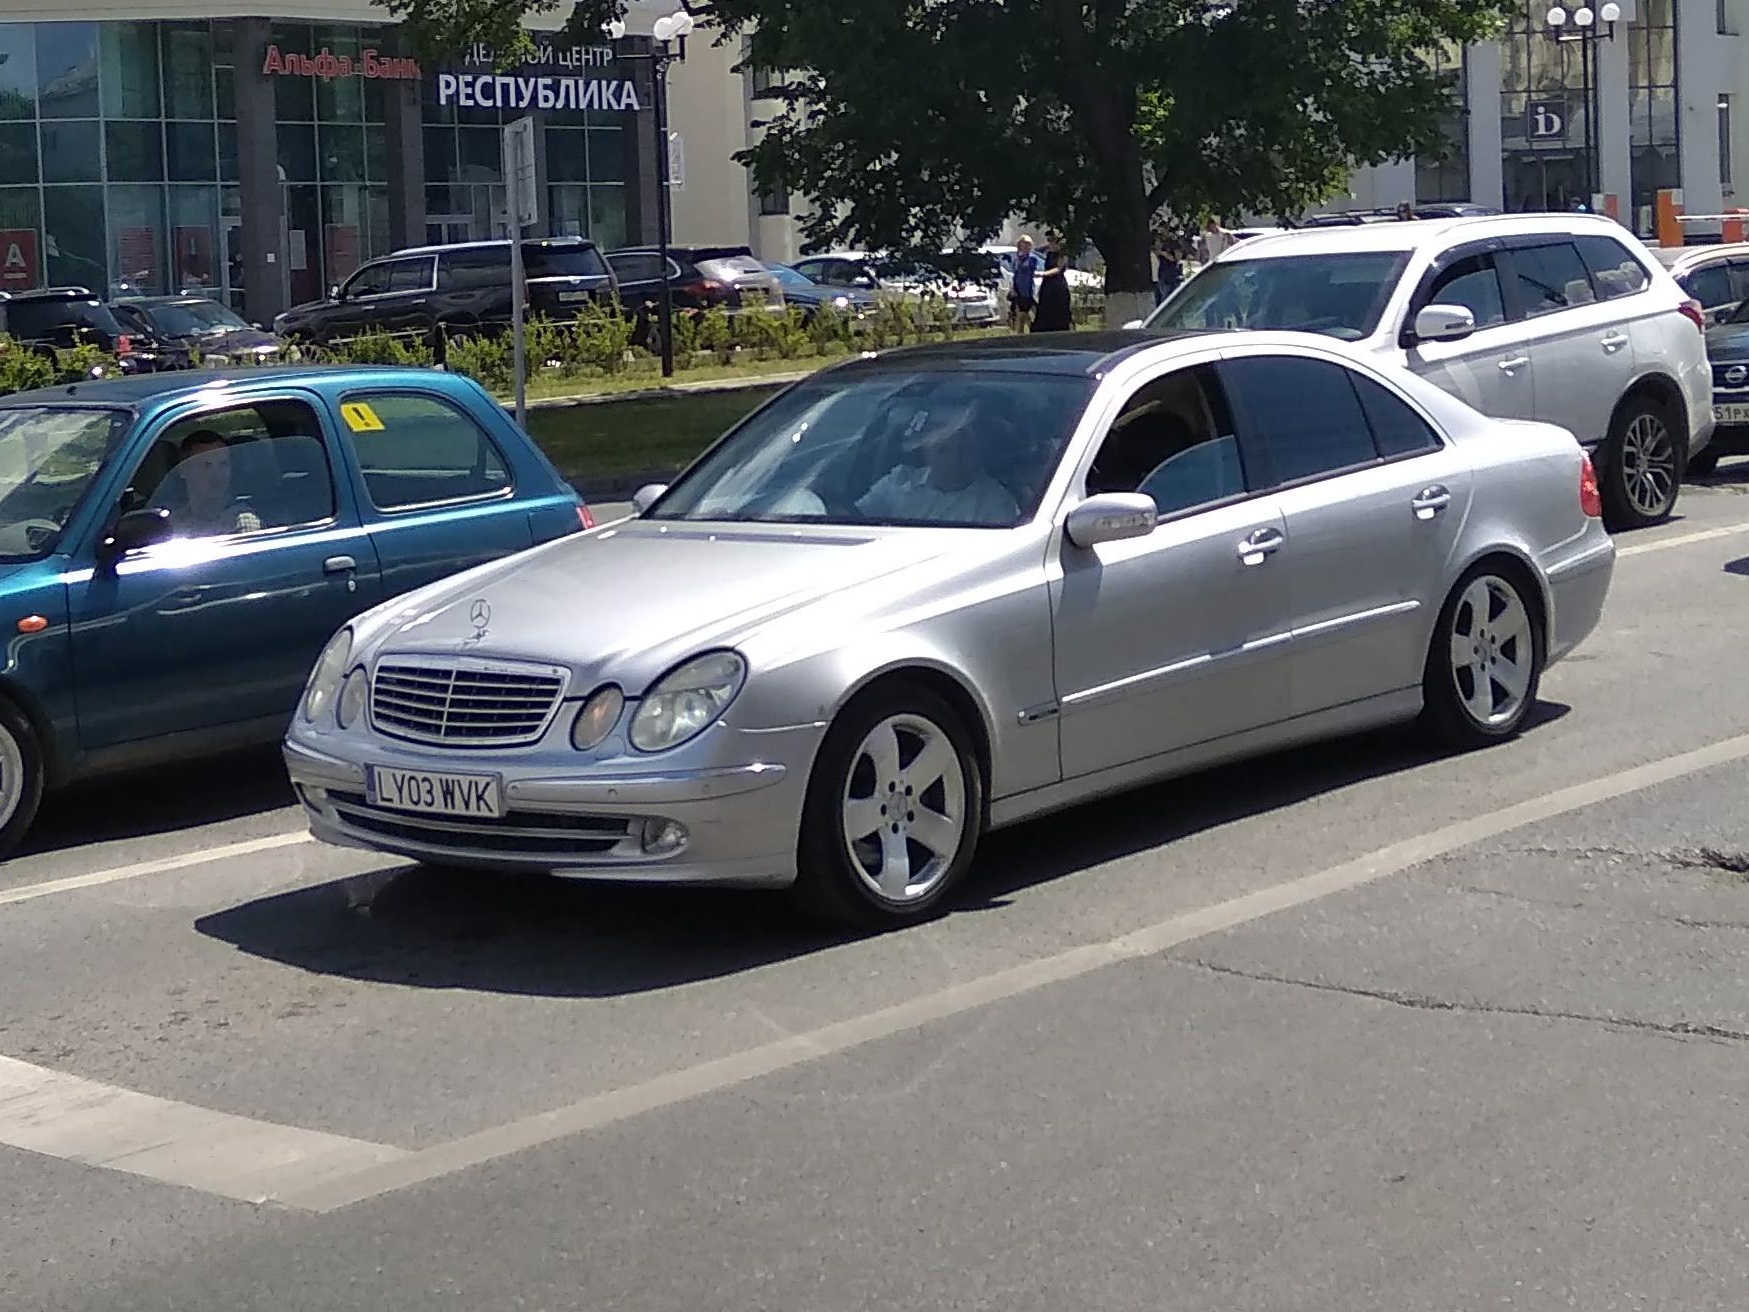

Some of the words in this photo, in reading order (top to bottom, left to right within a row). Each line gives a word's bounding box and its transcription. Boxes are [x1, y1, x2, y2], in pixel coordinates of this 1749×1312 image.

[558, 45, 613, 70] ЦЕНТР
[438, 73, 640, 111] РЕСПУБЛИКА
[377, 771, 436, 808] LY03
[439, 777, 495, 813] WVK
